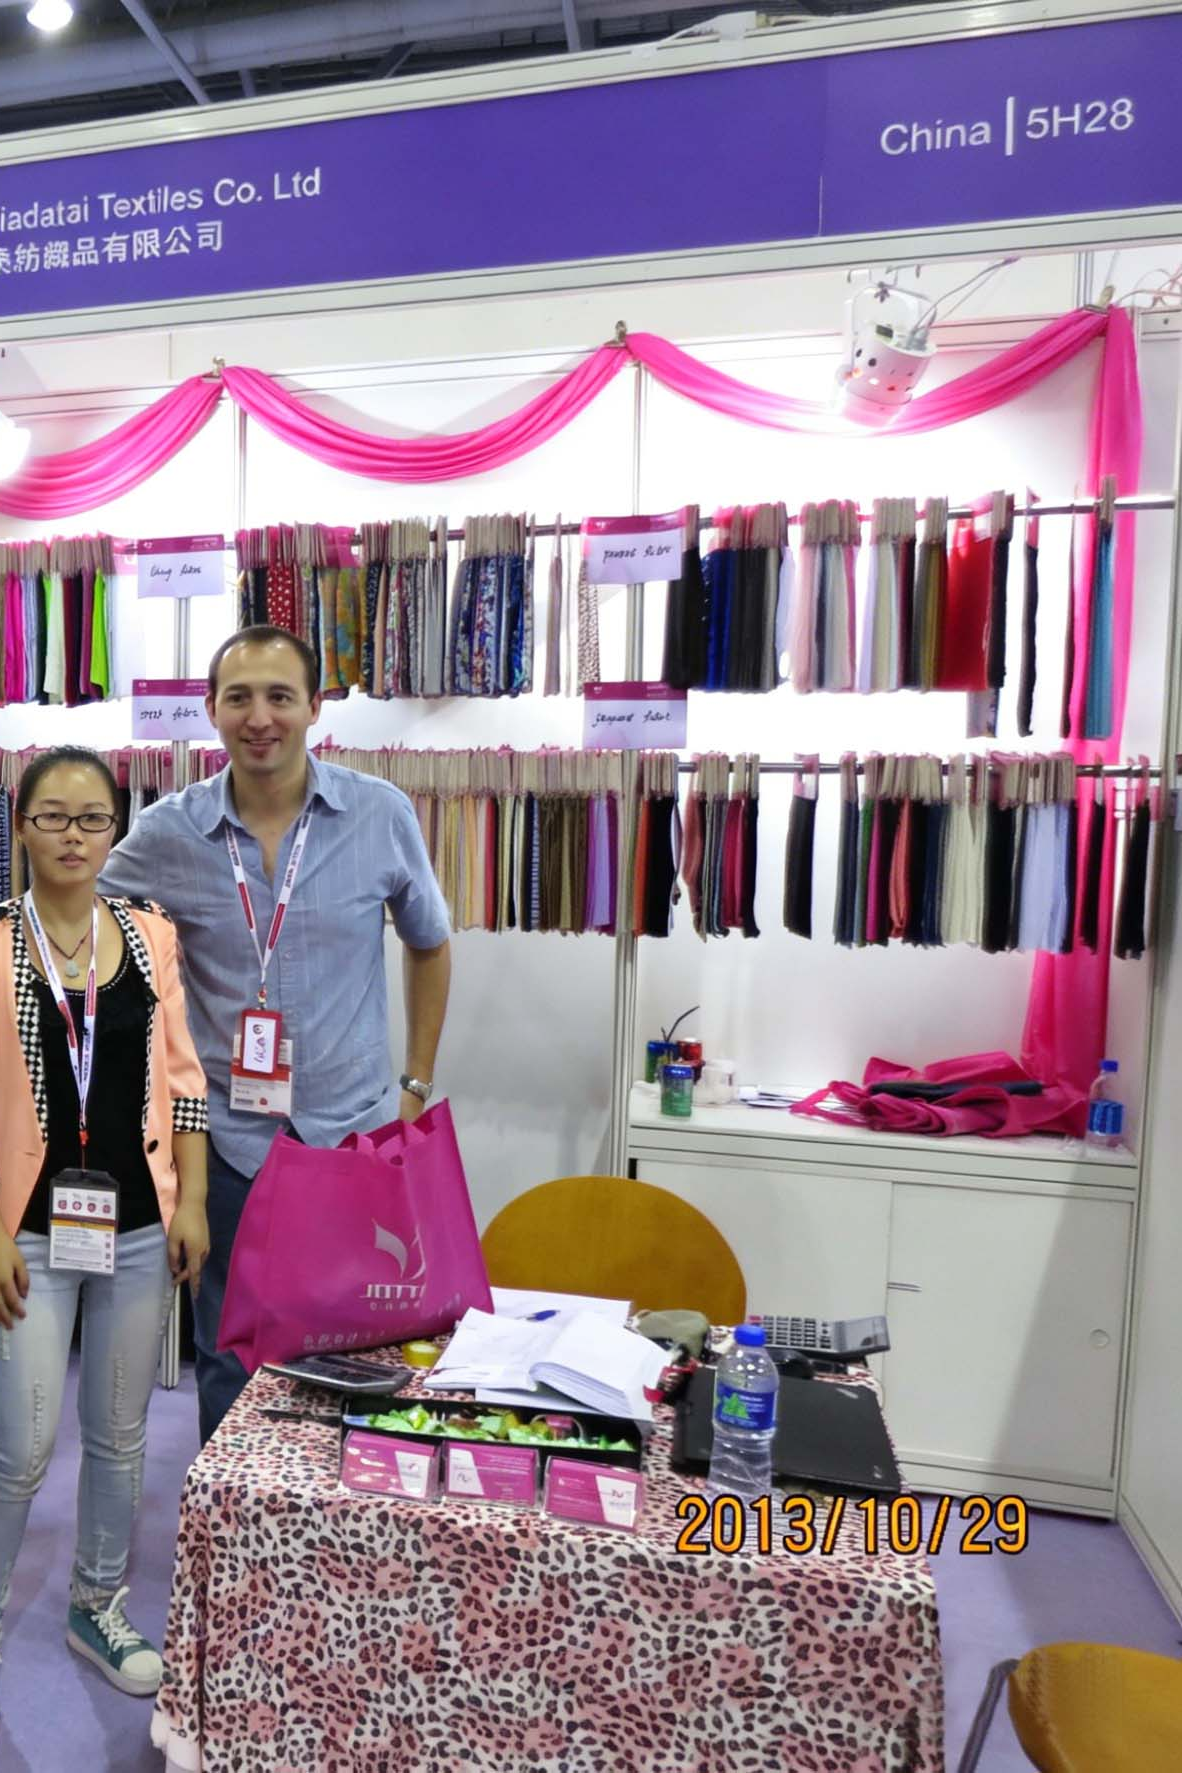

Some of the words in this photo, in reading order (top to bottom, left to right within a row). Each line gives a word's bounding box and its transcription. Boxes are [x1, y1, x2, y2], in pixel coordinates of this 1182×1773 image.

[880, 119, 992, 156] China
[1025, 98, 1135, 140] 5H28
[97, 186, 204, 220] Textiles
[213, 178, 263, 206] Co.
[273, 166, 321, 200] Ltd
